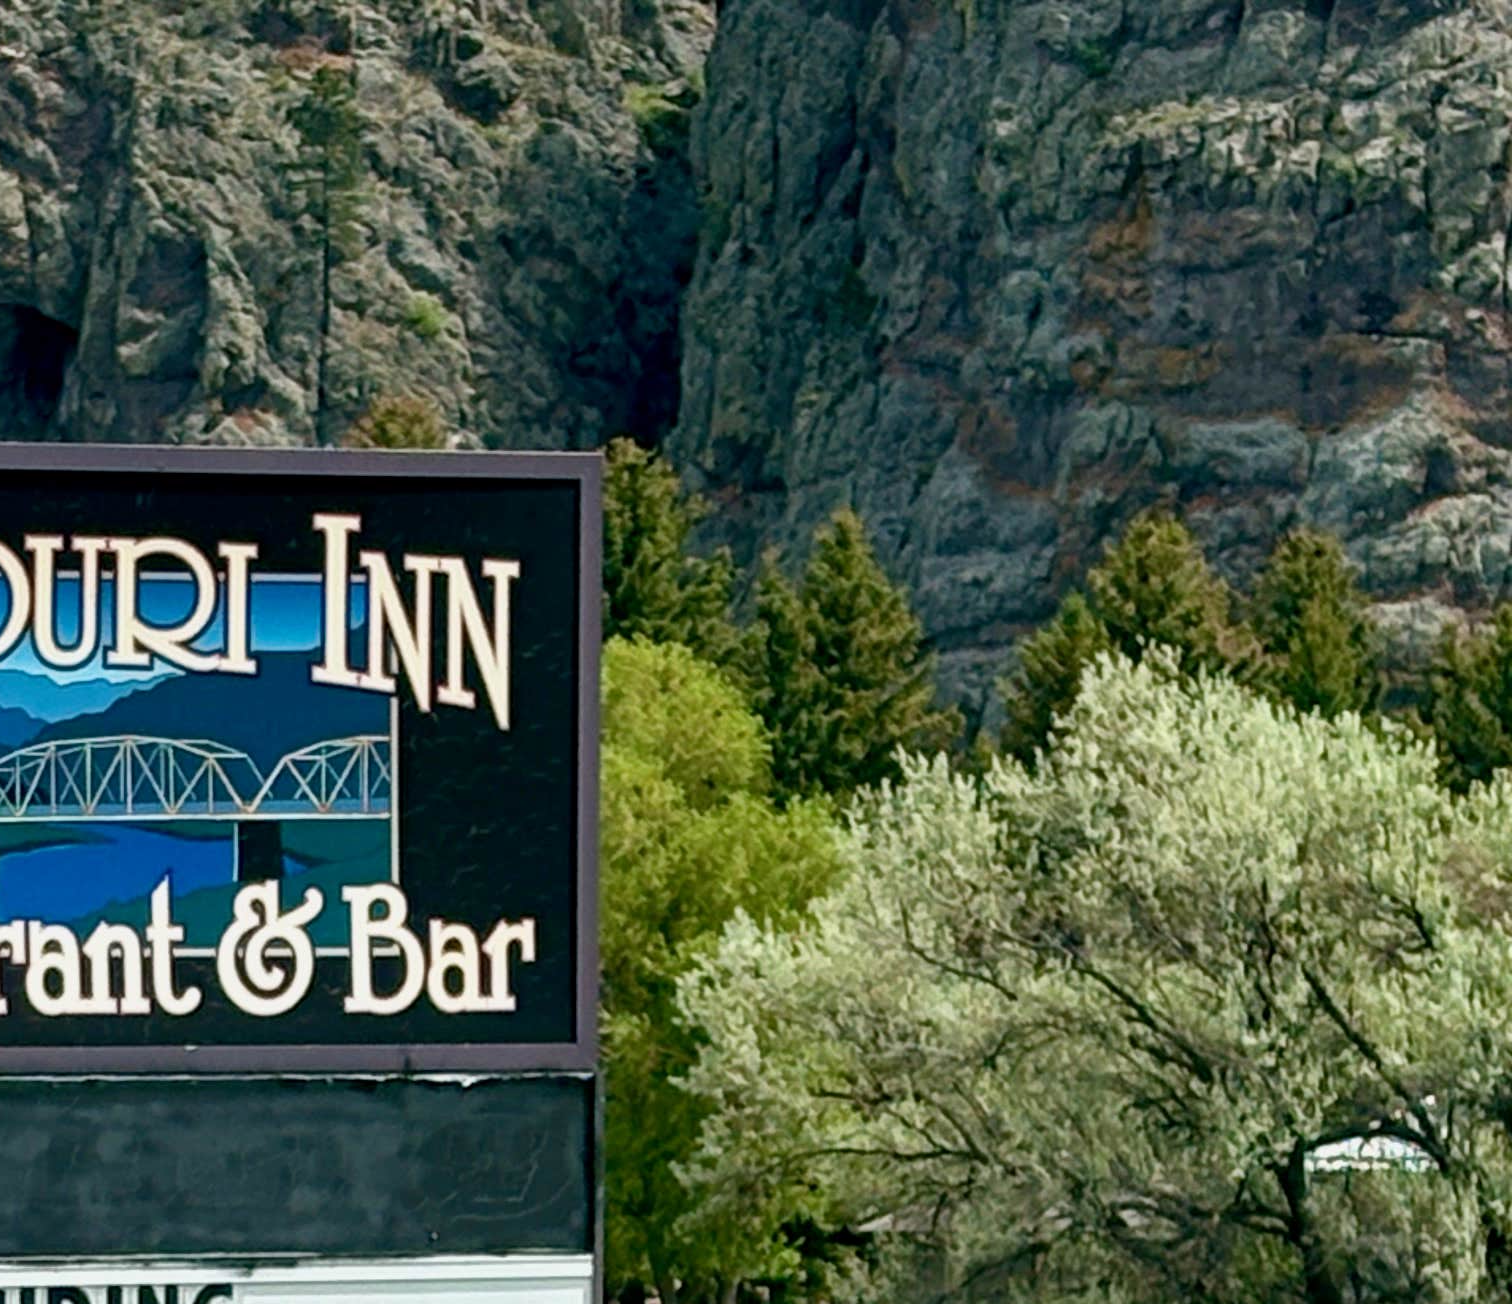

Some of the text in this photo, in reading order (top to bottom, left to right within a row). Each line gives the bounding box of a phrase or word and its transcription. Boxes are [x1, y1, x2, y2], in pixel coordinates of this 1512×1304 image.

[310, 513, 520, 731] INN
[217, 878, 324, 1016] &
[341, 882, 536, 1014] Bar
